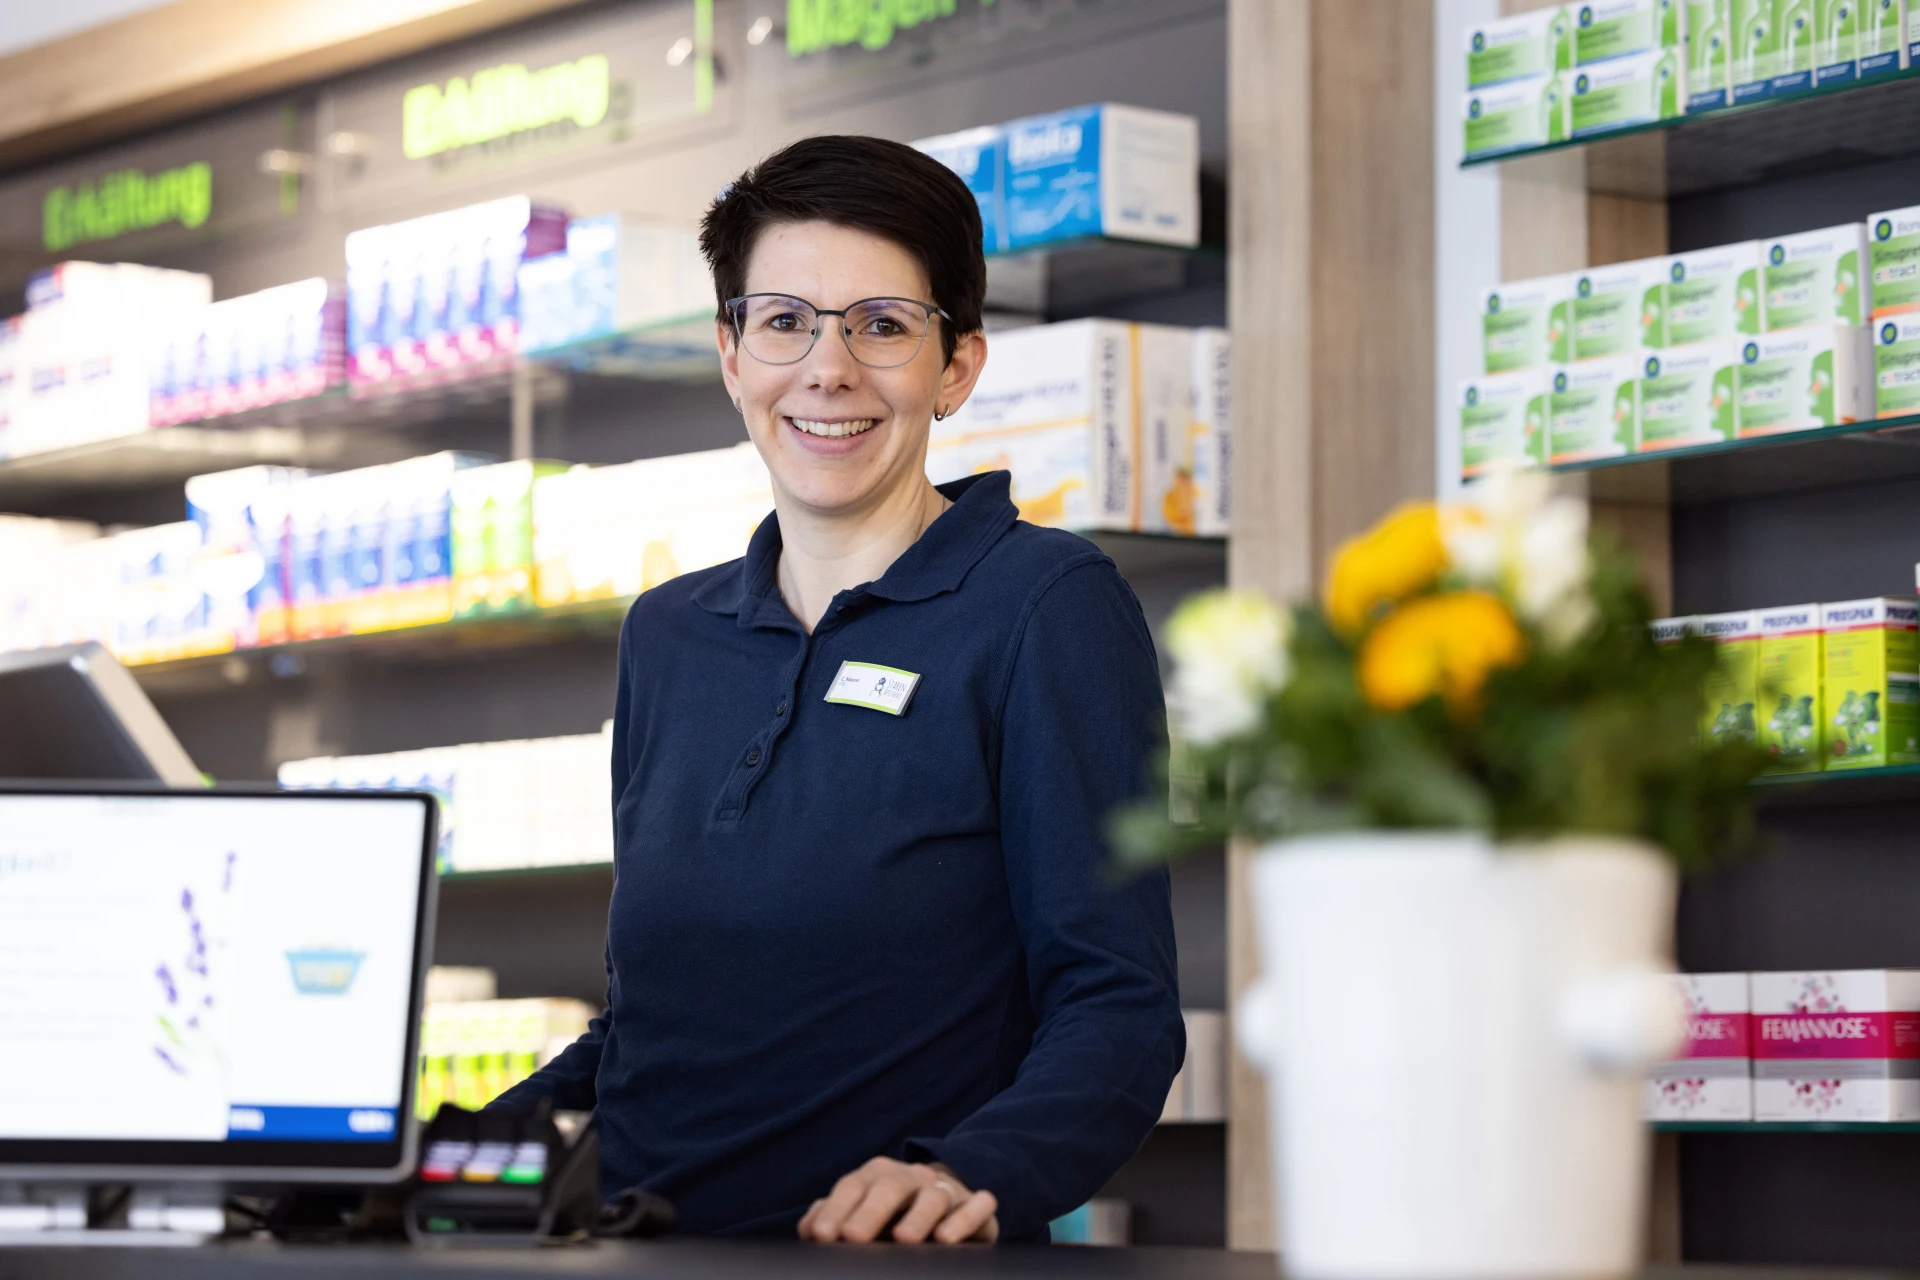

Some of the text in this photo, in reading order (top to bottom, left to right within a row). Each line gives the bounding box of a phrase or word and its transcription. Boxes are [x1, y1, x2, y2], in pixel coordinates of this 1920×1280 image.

[403, 54, 609, 160] Erkältung
[43, 160, 212, 252] Erkältung
[1763, 614, 1808, 628] PROSPAN
[1827, 608, 1874, 622] PROSPAN
